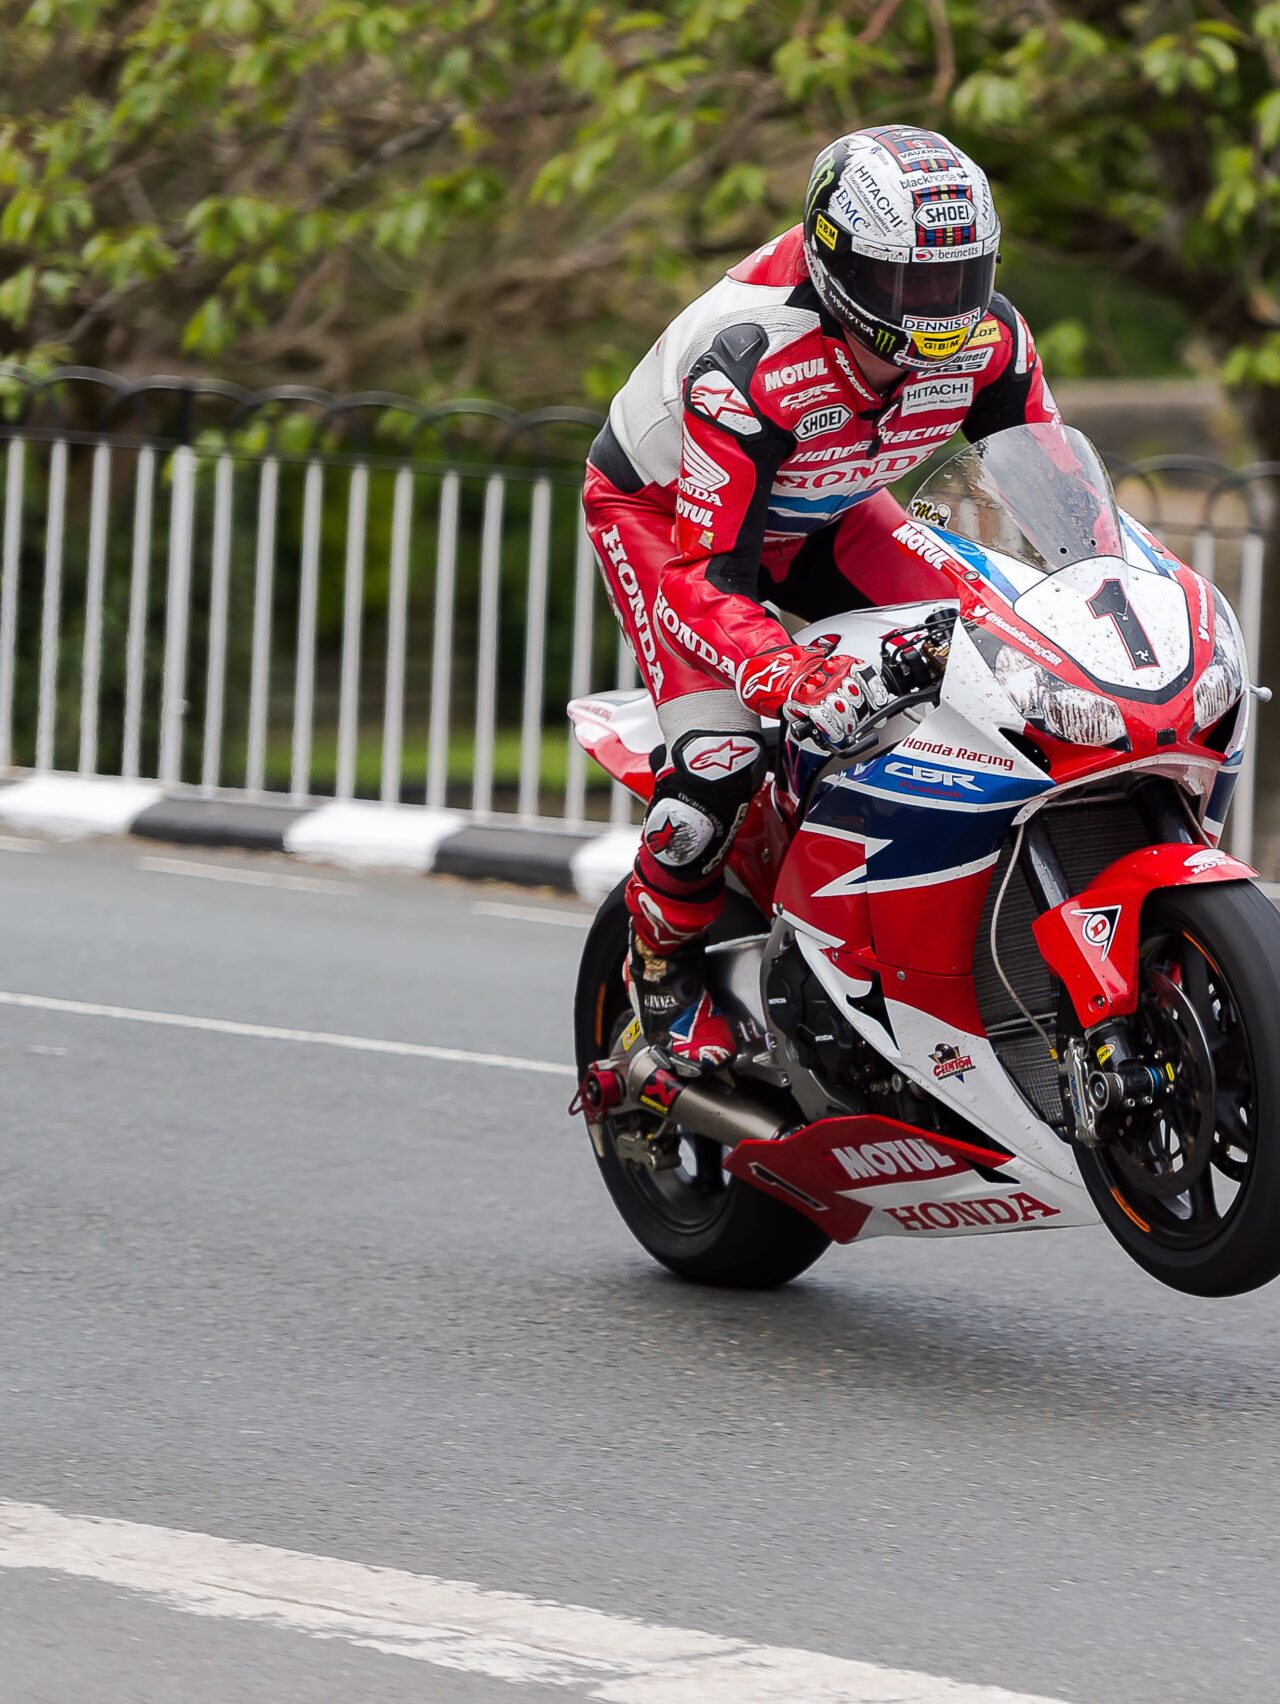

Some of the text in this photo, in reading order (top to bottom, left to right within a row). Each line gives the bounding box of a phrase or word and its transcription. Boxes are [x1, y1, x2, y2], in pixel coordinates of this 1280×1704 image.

[854, 165, 903, 228] HITACHI
[900, 172, 957, 189] blackhorse
[925, 205, 970, 223] SHOEI
[938, 245, 979, 260] bennetts
[903, 311, 979, 331] DENNISON
[764, 358, 828, 392] MOTUL
[907, 383, 969, 401] HITACHI
[780, 383, 841, 408] CBR
[801, 410, 842, 436] SHOEI
[789, 419, 963, 464] Honda Racing
[677, 477, 723, 507] ONDA
[676, 493, 714, 528] OTUL
[891, 521, 949, 570] MOTUL
[601, 524, 665, 700] HONDA
[1086, 578, 1160, 671] 1
[656, 586, 737, 682] HONDA
[902, 737, 1015, 772] Honda Racing
[884, 761, 985, 792] CBR
[832, 1138, 956, 1180] MOTUL
[883, 1191, 1062, 1232] HONDA
